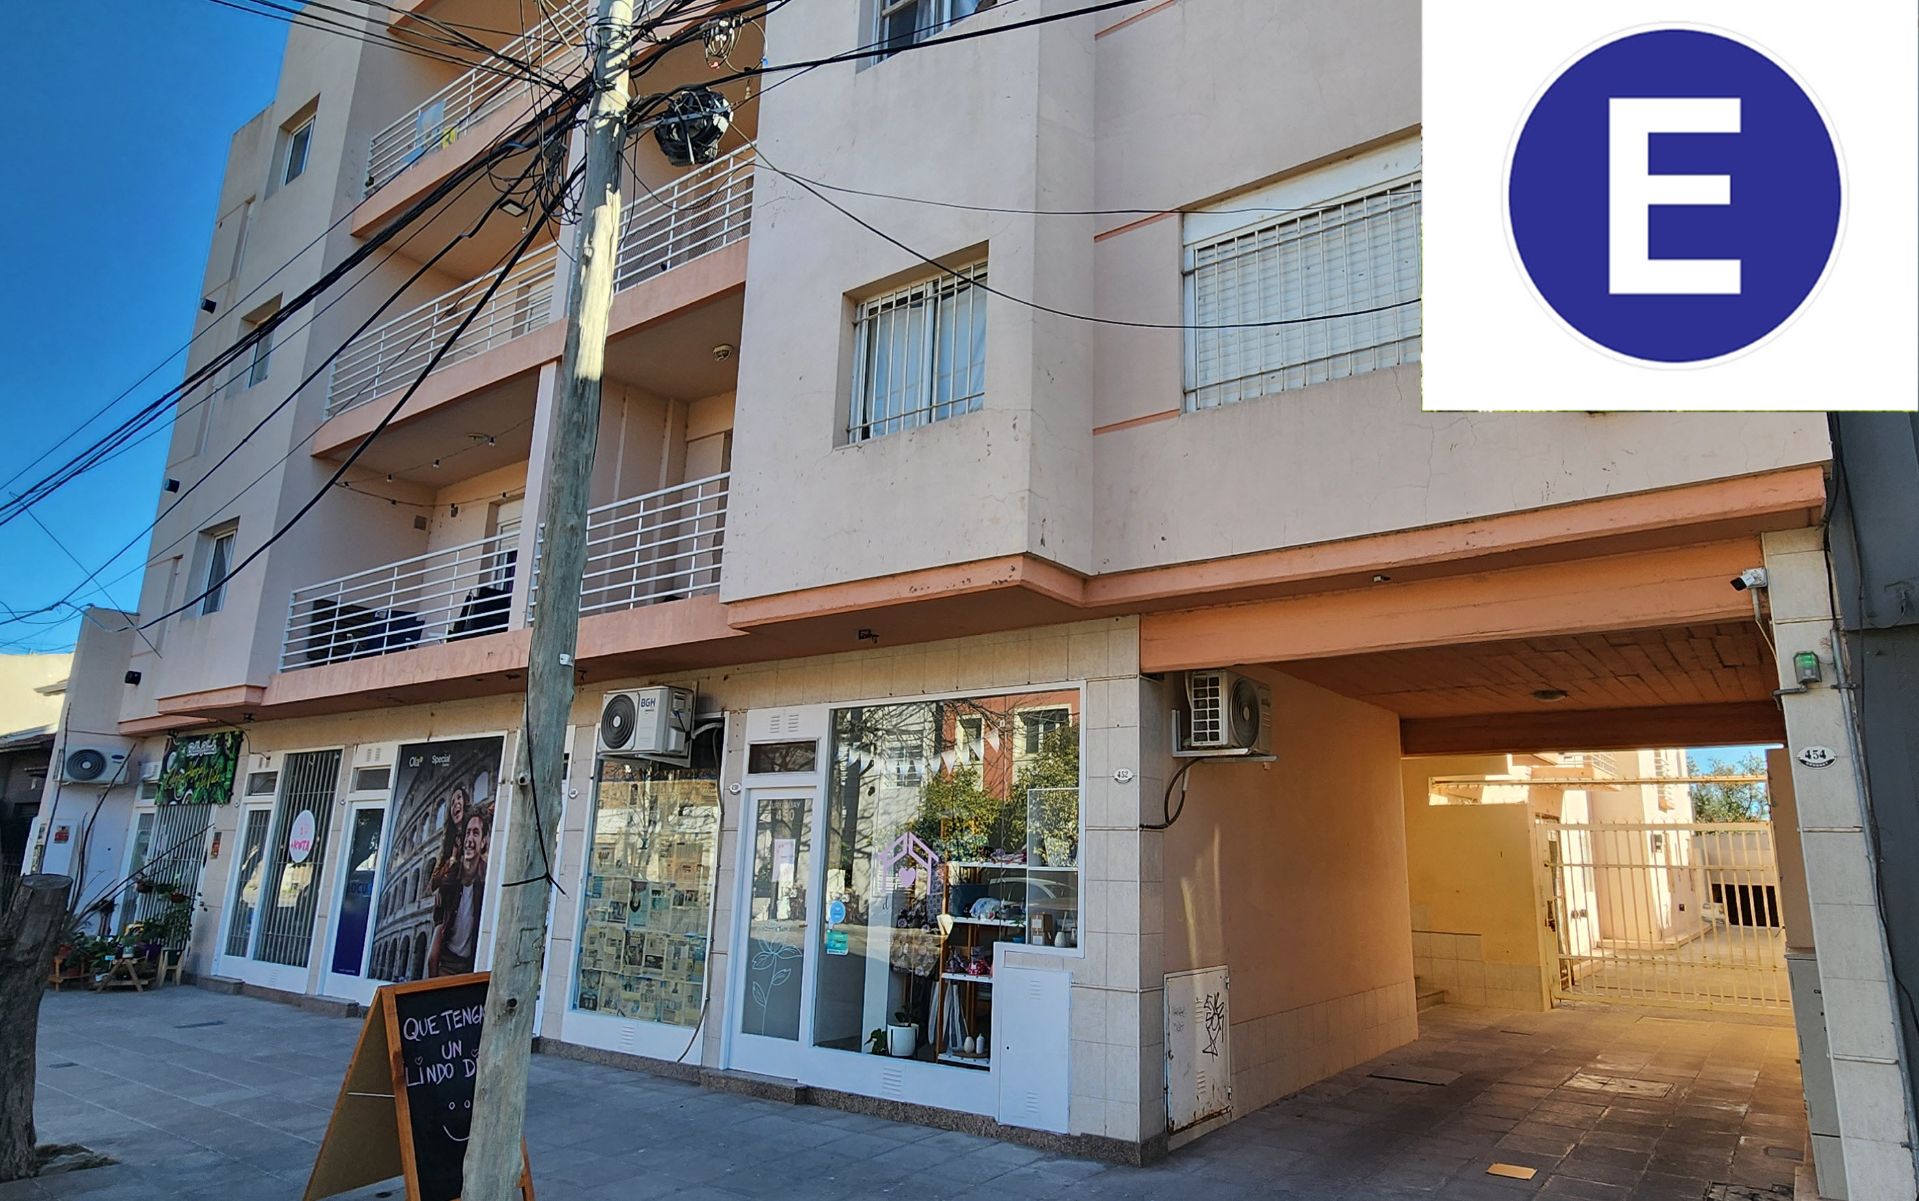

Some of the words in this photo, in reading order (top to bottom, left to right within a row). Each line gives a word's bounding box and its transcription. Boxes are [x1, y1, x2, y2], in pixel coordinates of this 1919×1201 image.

[640, 697, 656, 708] BGH
[1804, 749, 1827, 760] 454
[403, 1015, 440, 1041] QUE
[441, 1040, 462, 1060] UN
